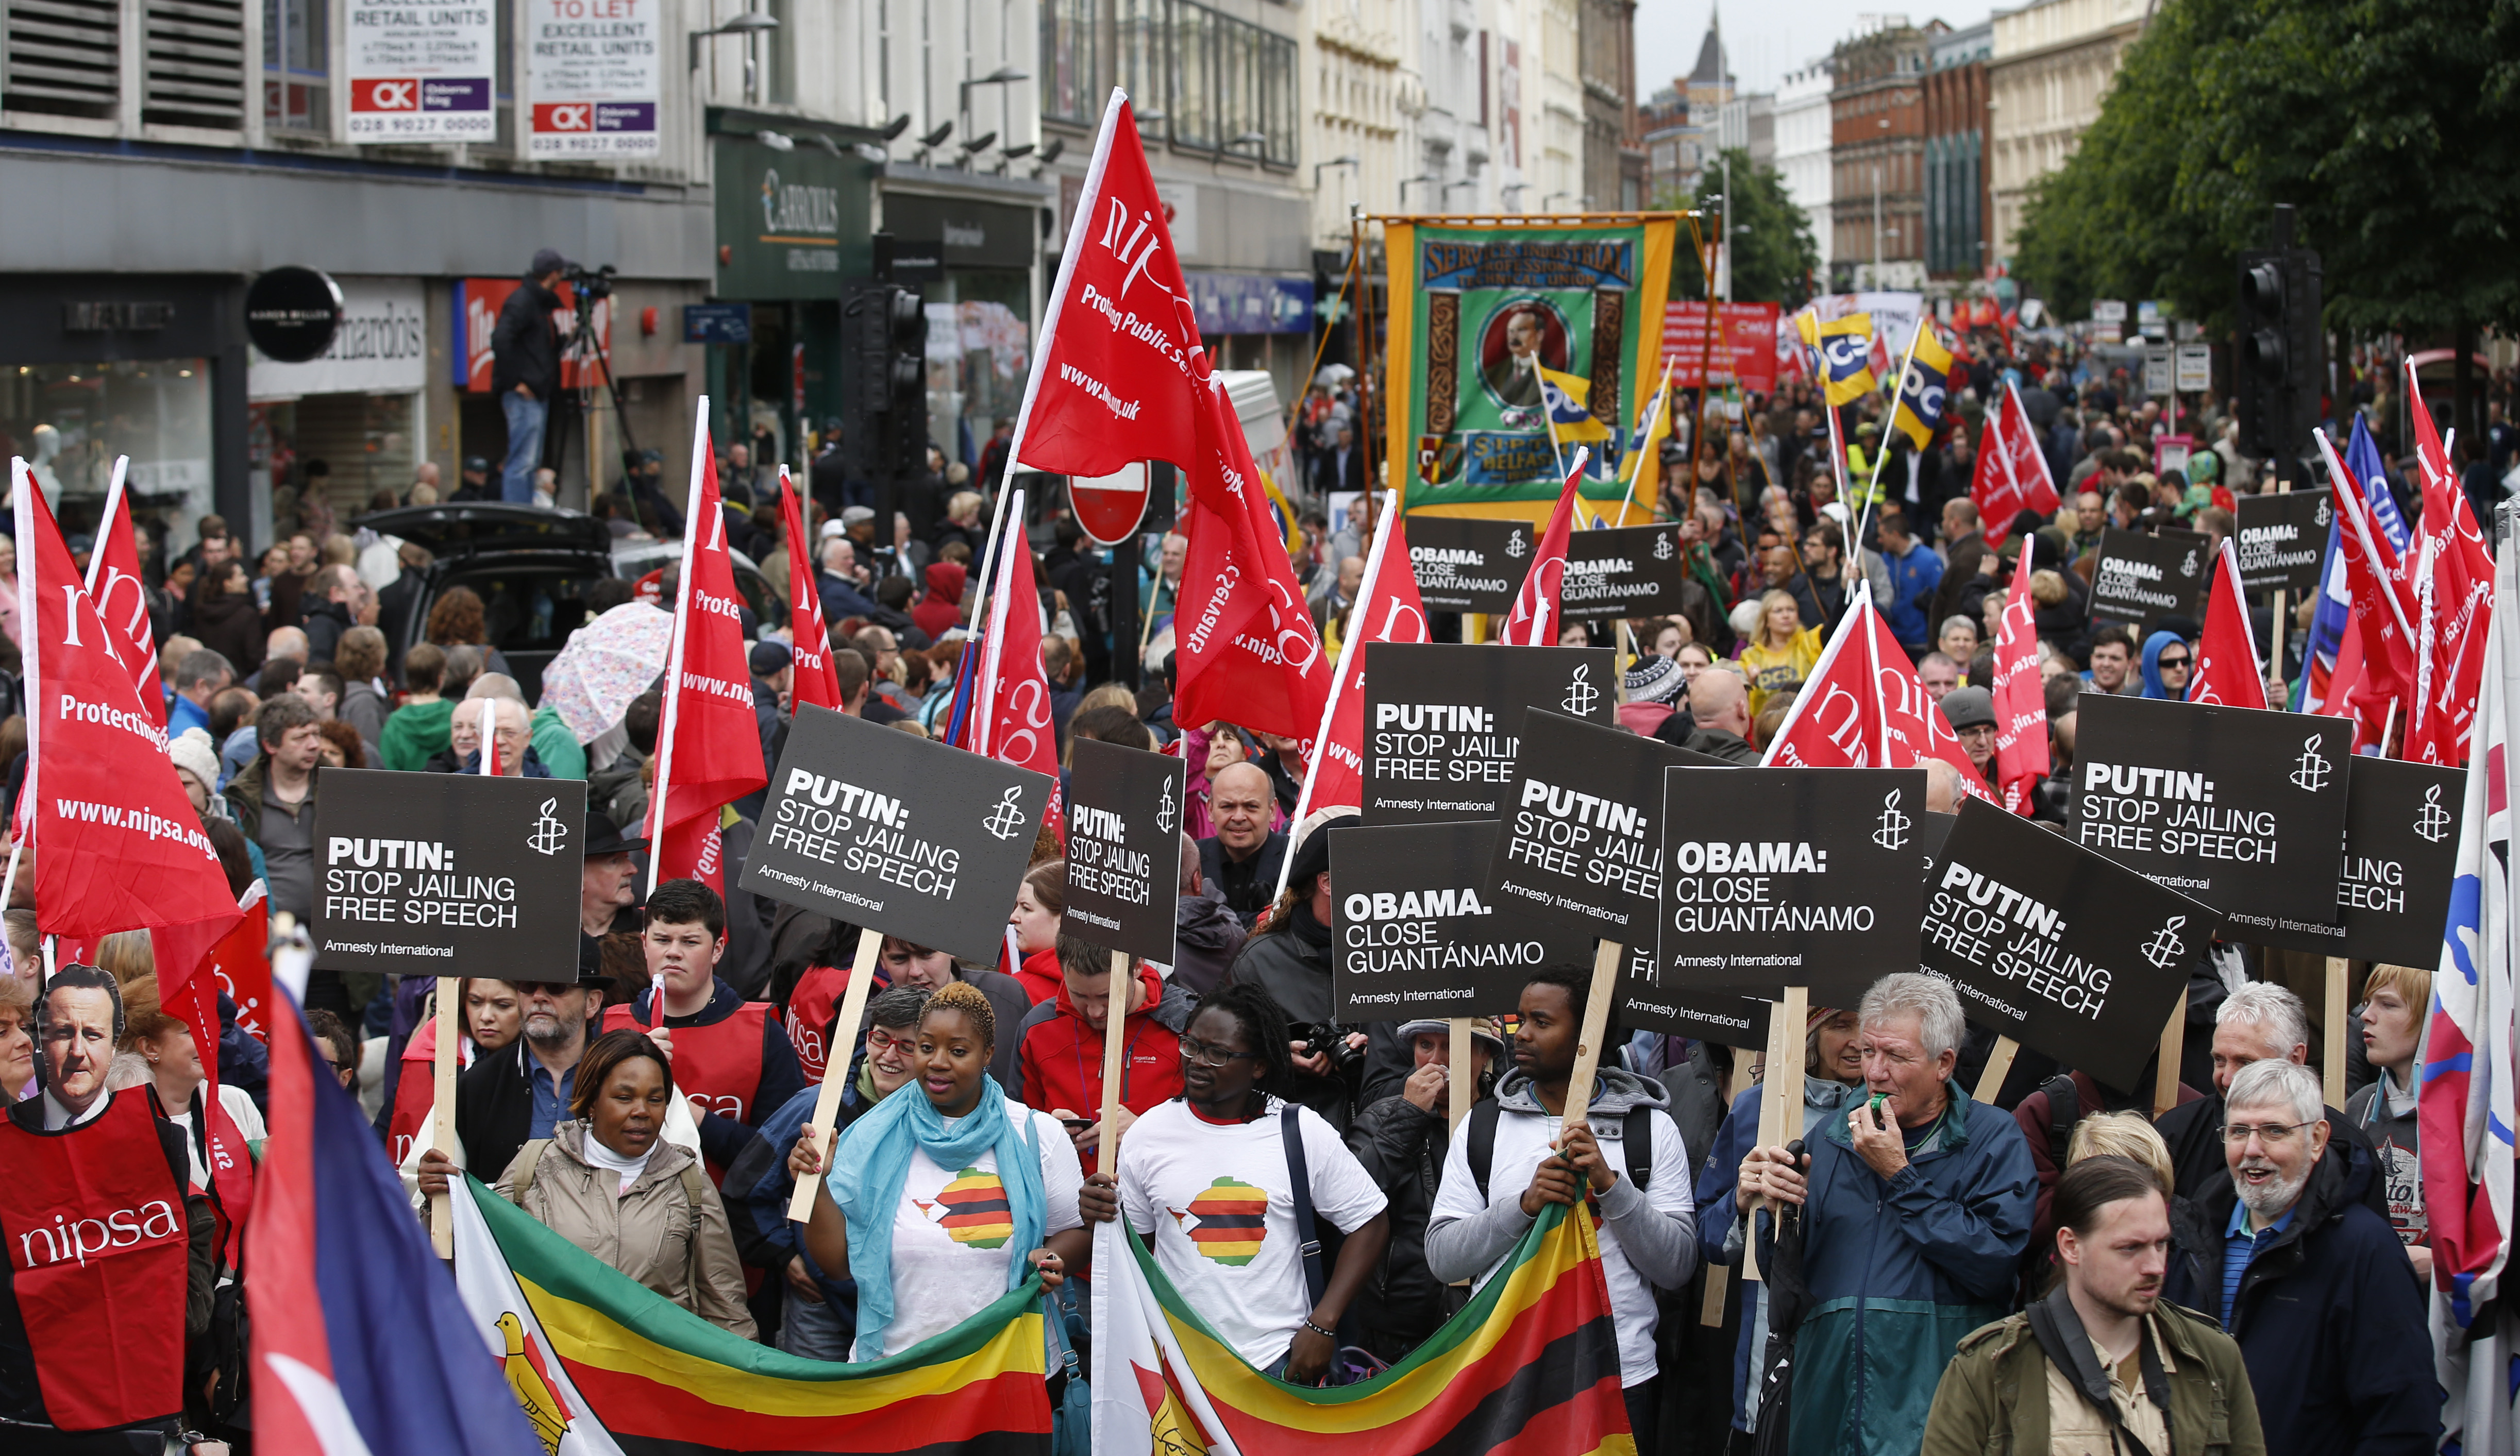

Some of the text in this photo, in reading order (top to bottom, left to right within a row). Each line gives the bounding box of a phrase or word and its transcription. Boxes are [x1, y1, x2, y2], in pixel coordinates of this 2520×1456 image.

[355, 10, 488, 25] RETAIL UNITS
[551, 0, 636, 18] TO LET
[543, 23, 646, 38] EXCELLENT
[535, 41, 654, 56] RETAIL UNITS
[1427, 243, 1628, 280] SERVICES INDUSTRIAL
[1547, 273, 1597, 286] UNION
[1121, 311, 1173, 355] Public
[2239, 540, 2277, 557] CLOSE
[2240, 524, 2299, 544] OBAMA:
[1409, 546, 1484, 566] OBAMA:
[1412, 563, 1455, 577] CLOSE
[1563, 558, 1634, 576] OBAMA:
[2101, 556, 2162, 582] OBAMA:
[1561, 574, 1606, 588] CLOSE
[1562, 582, 1659, 601] GUANTÁNAMO
[2098, 572, 2138, 587] CLOSE
[683, 672, 755, 710] www.nip
[1376, 703, 1493, 733] PUTIN:
[1375, 733, 1446, 756] STOP
[1375, 757, 1440, 781] FREE
[2085, 762, 2214, 803] PUTIN:
[784, 767, 910, 830] PUTIN:
[1374, 797, 1495, 812] Amnesty International
[1520, 778, 1647, 839] PUTIN:
[1072, 804, 1125, 844] PUTIN:
[2082, 794, 2275, 836] STOP JAILING
[777, 798, 960, 874] STOP JAILING
[1514, 811, 1661, 872] STOP JAILI
[2080, 821, 2276, 864] FREE SPEECH
[328, 837, 454, 871] PUTIN:
[768, 822, 956, 900] FREE SPEECH
[1070, 836, 1150, 878] STOP JAILING
[1508, 836, 1581, 877] FREE
[1677, 841, 1827, 873] OBAMA:
[326, 869, 515, 901] STOP JAILING
[758, 864, 884, 912] Amnesty International
[1069, 862, 1150, 906] FREE SPEECH
[1676, 877, 1770, 903] CLOSE
[326, 895, 517, 928] FREE SPEECH
[1067, 905, 1120, 930] Amnesty International
[1501, 880, 1629, 925] Amnesty International
[1675, 900, 1874, 933] GUANTÁNAMO
[1940, 861, 2061, 942] PUTIN:
[1346, 921, 1438, 948] CLOSE
[2228, 912, 2346, 937] Amnesty International
[324, 939, 453, 957] Amnesty International
[1347, 940, 1544, 974] GUANTÁNAMO
[1929, 892, 2111, 995] STOP JAILING
[1674, 953, 1802, 970] Amnesty International
[1920, 915, 2105, 1020] FREE SPEECH
[1349, 987, 1474, 1005] Amnesty International
[1956, 979, 2027, 1021] International
[1626, 997, 1750, 1030] Amnesty International
[19, 1199, 181, 1268] nipsa
